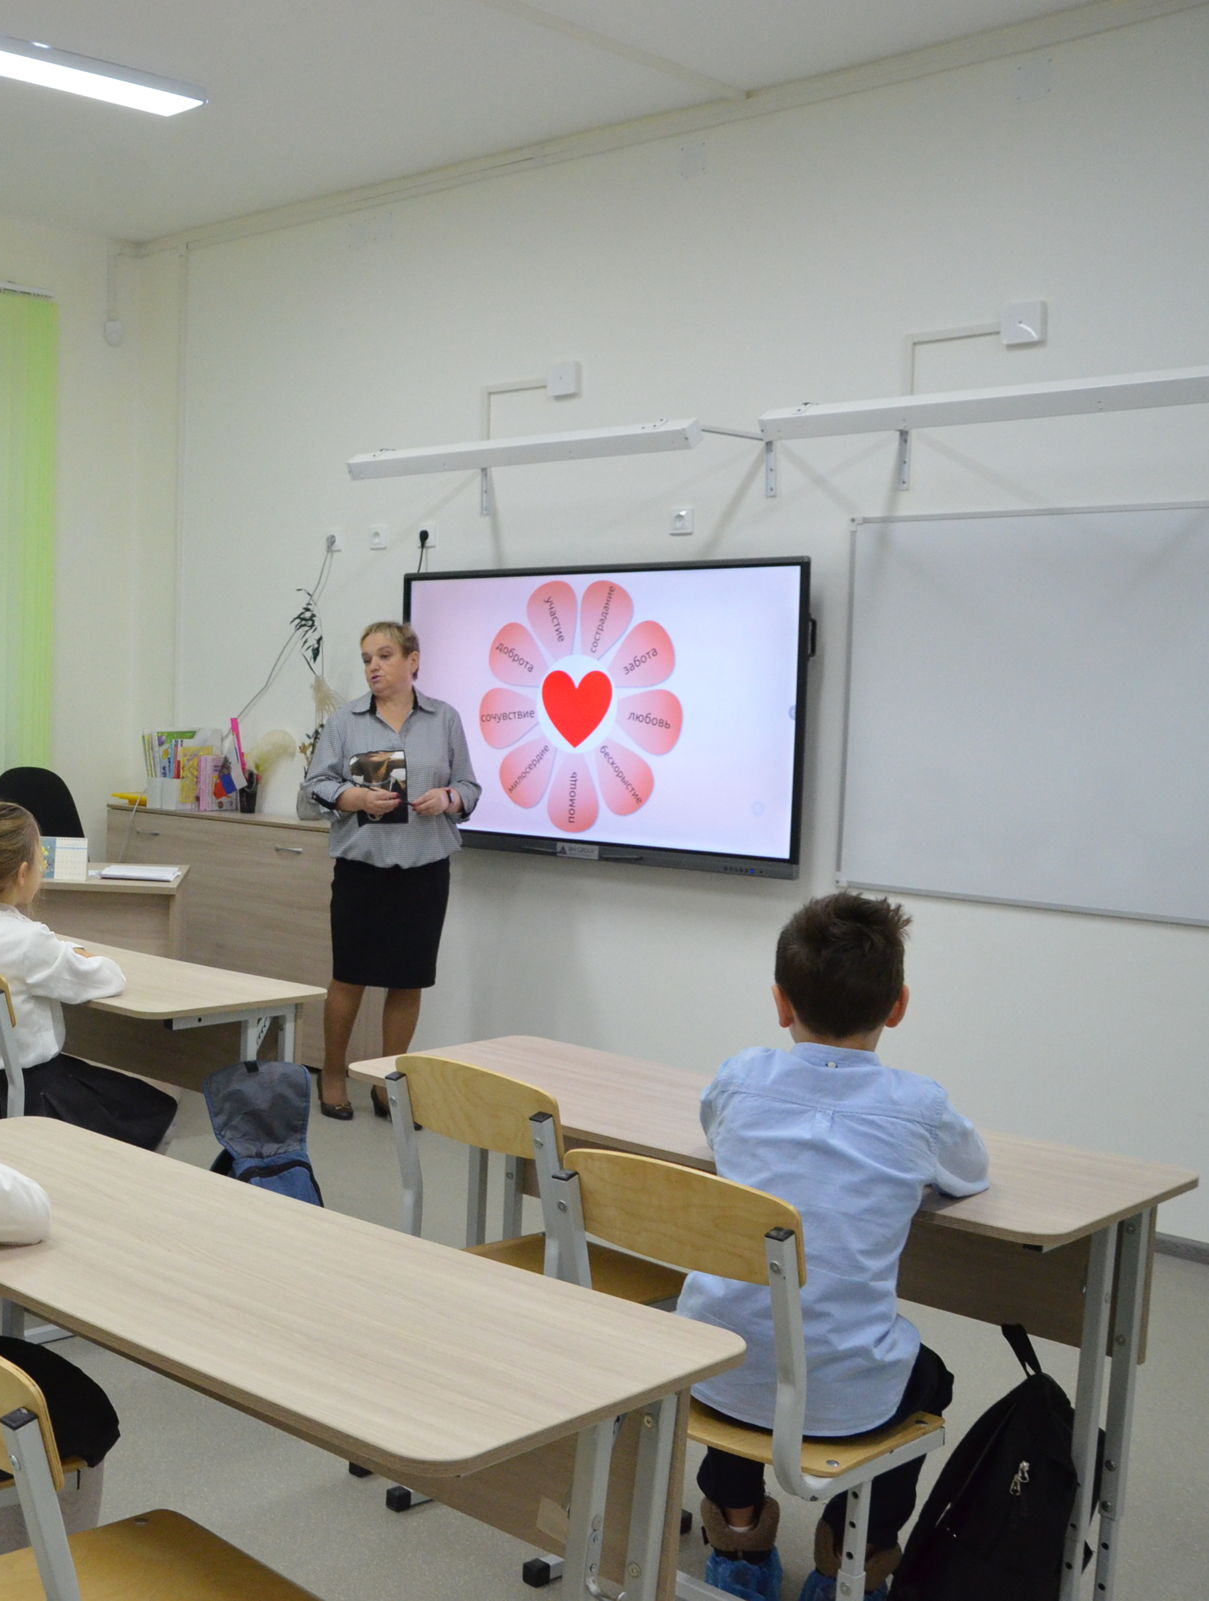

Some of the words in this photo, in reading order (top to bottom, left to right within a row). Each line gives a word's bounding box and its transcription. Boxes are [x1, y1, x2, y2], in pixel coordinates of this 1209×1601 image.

[543, 595, 565, 642] участие
[590, 585, 616, 654] сострадание
[495, 642, 535, 673] доброта
[623, 647, 659, 676] забота
[480, 708, 536, 725] сочувствие
[627, 711, 671, 730] любовь
[508, 744, 550, 794] милосердие
[599, 745, 643, 804] бескорыстие
[567, 771, 578, 823] помощь
